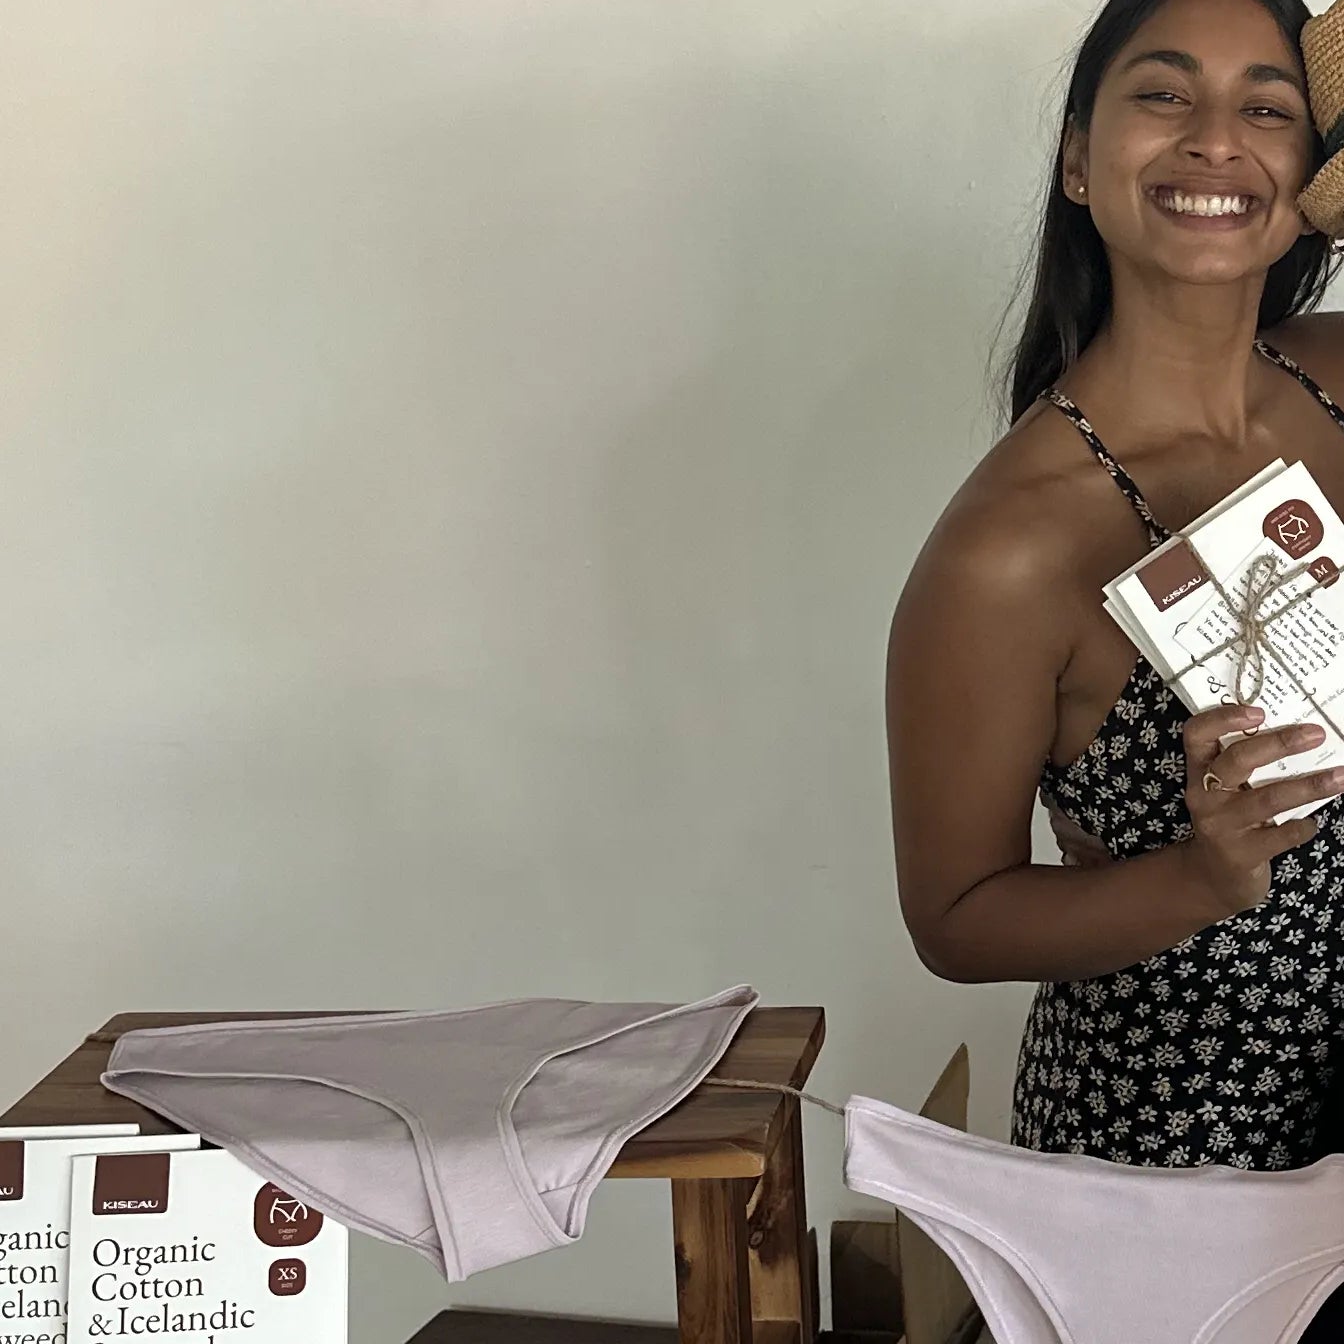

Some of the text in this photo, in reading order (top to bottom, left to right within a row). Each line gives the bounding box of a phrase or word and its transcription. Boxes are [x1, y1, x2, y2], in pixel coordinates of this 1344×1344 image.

[1314, 563, 1329, 579] M
[1161, 574, 1202, 605] KISEAU
[103, 1200, 159, 1210] KISEAU
[92, 1235, 216, 1276] Organic
[278, 1267, 298, 1281] XS
[91, 1272, 204, 1302] Cotton
